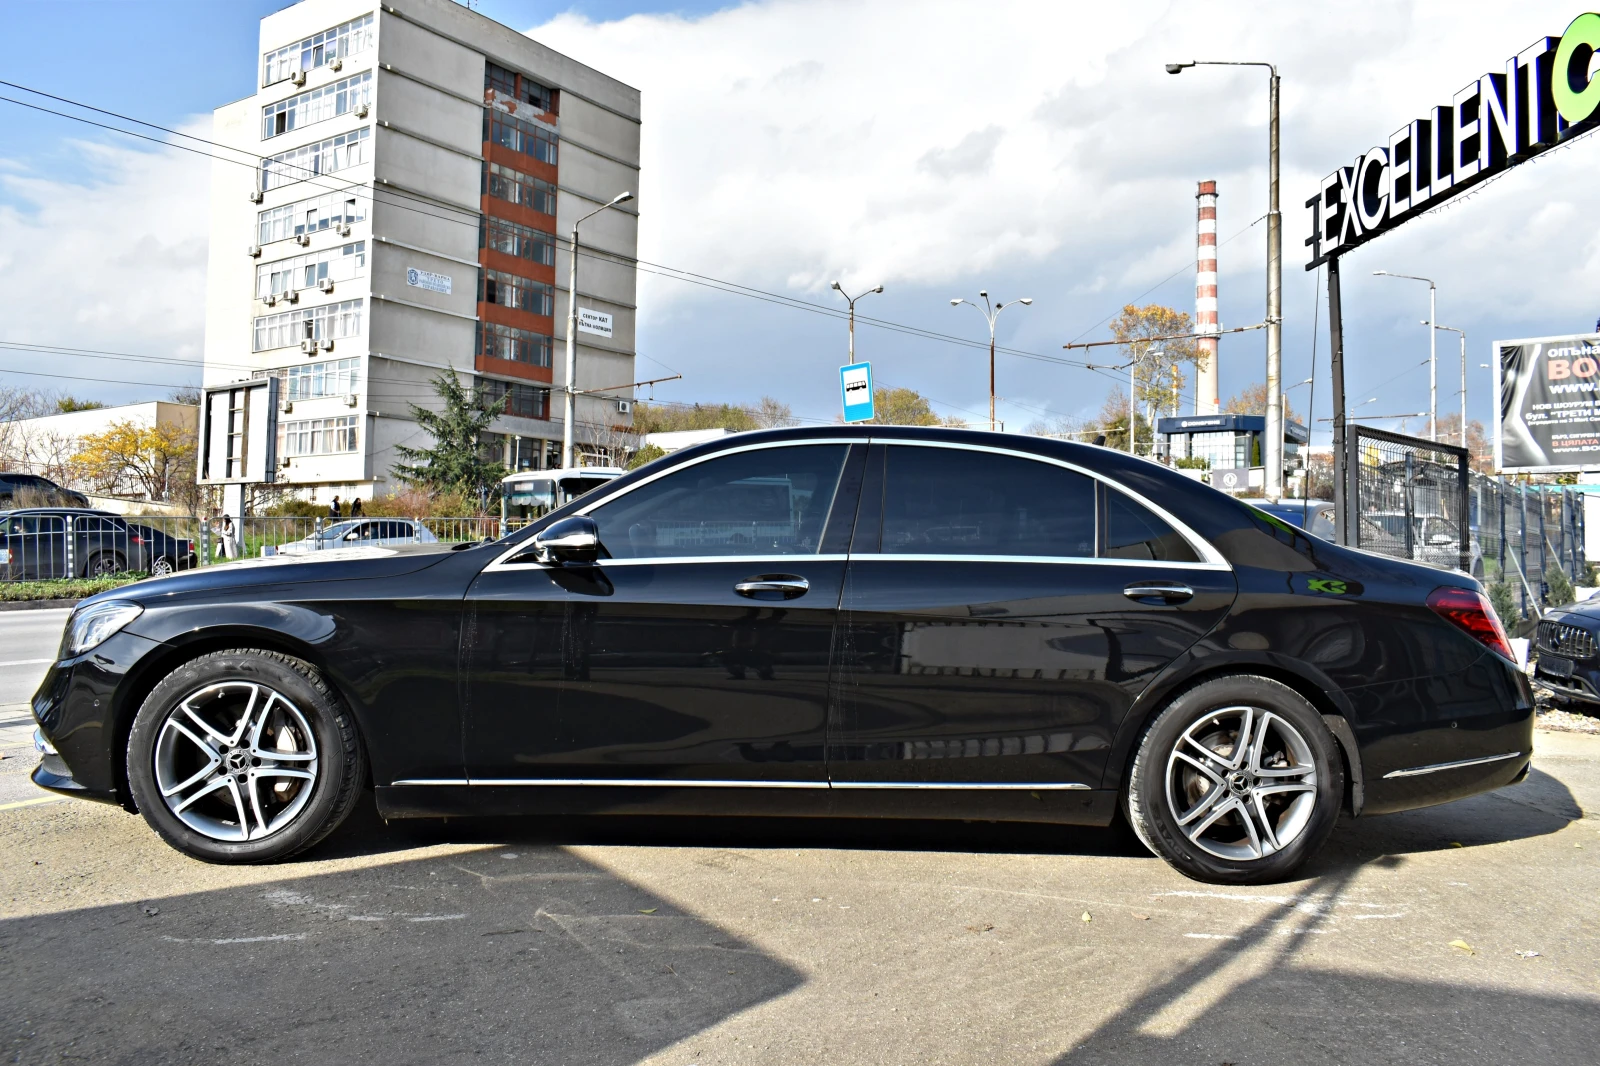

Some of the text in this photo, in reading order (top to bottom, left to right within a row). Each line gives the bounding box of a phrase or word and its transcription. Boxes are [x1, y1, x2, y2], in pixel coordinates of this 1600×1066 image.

[1321, 36, 1549, 255] EXCELLENT
[1548, 357, 1600, 380] BO
[1549, 382, 1600, 394] www.
[1525, 412, 1548, 421] бул.
[1561, 438, 1599, 447] ЦЯЛАТА
[1552, 445, 1600, 453] www.BO
